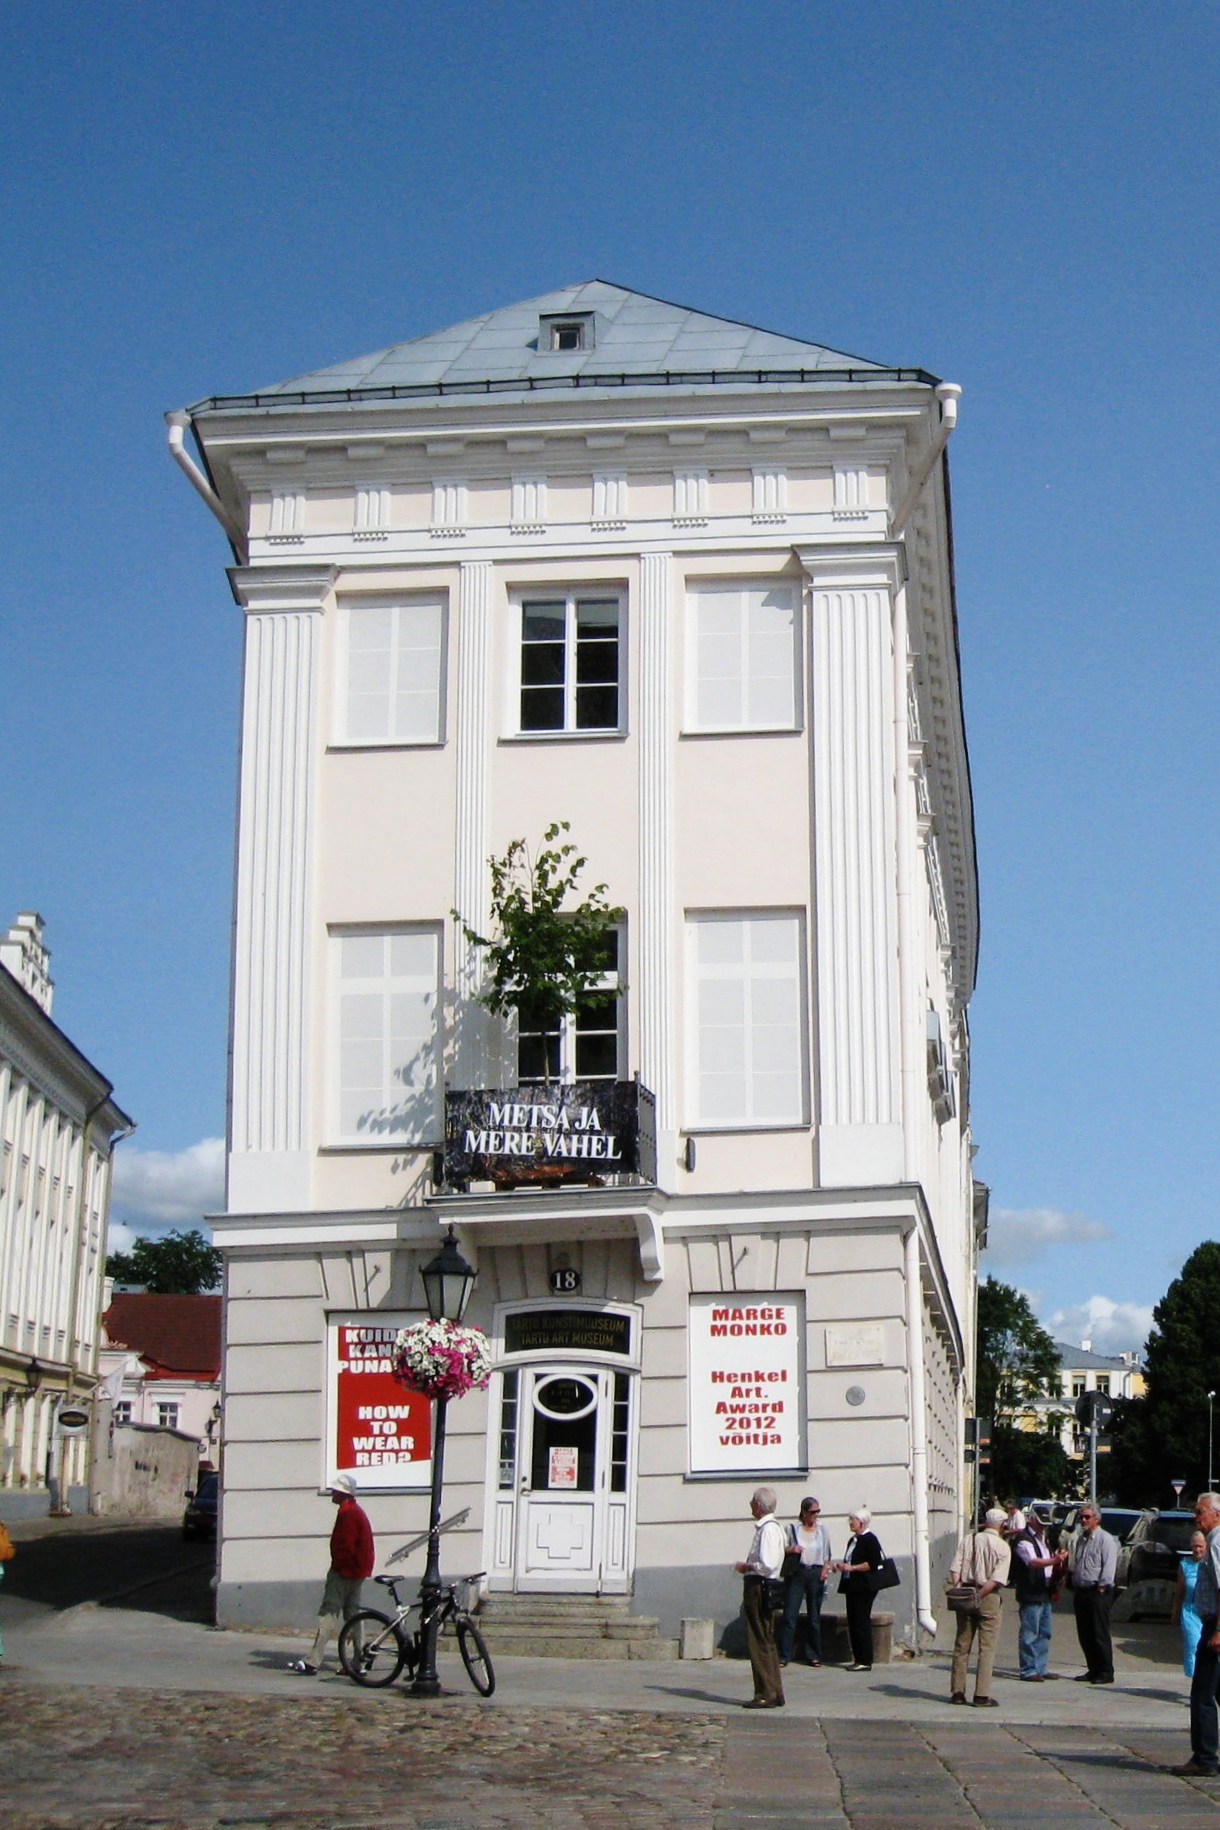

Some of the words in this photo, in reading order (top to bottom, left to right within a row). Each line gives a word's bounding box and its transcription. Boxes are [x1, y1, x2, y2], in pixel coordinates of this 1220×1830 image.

[489, 1103, 570, 1129] METSA
[574, 1107, 602, 1130] JA
[464, 1130, 536, 1156] MERE
[543, 1133, 622, 1159] VAHEL
[554, 1271, 576, 1289] 18
[712, 1307, 785, 1321] MARGE
[345, 1329, 397, 1343] KUID
[710, 1322, 787, 1337] MONKO
[521, 1333, 549, 1345] TARTU
[551, 1332, 570, 1343] ART
[572, 1332, 615, 1346] MUSEUM
[348, 1344, 392, 1359] KAN
[711, 1370, 787, 1383] Henkel
[730, 1386, 769, 1398] Art.
[358, 1405, 410, 1419] HOW
[715, 1401, 784, 1414] Award
[370, 1421, 397, 1435] TO
[725, 1416, 776, 1430] 2012
[352, 1436, 414, 1450] WEAR
[719, 1432, 782, 1445] võitja
[356, 1451, 412, 1466] RED?
